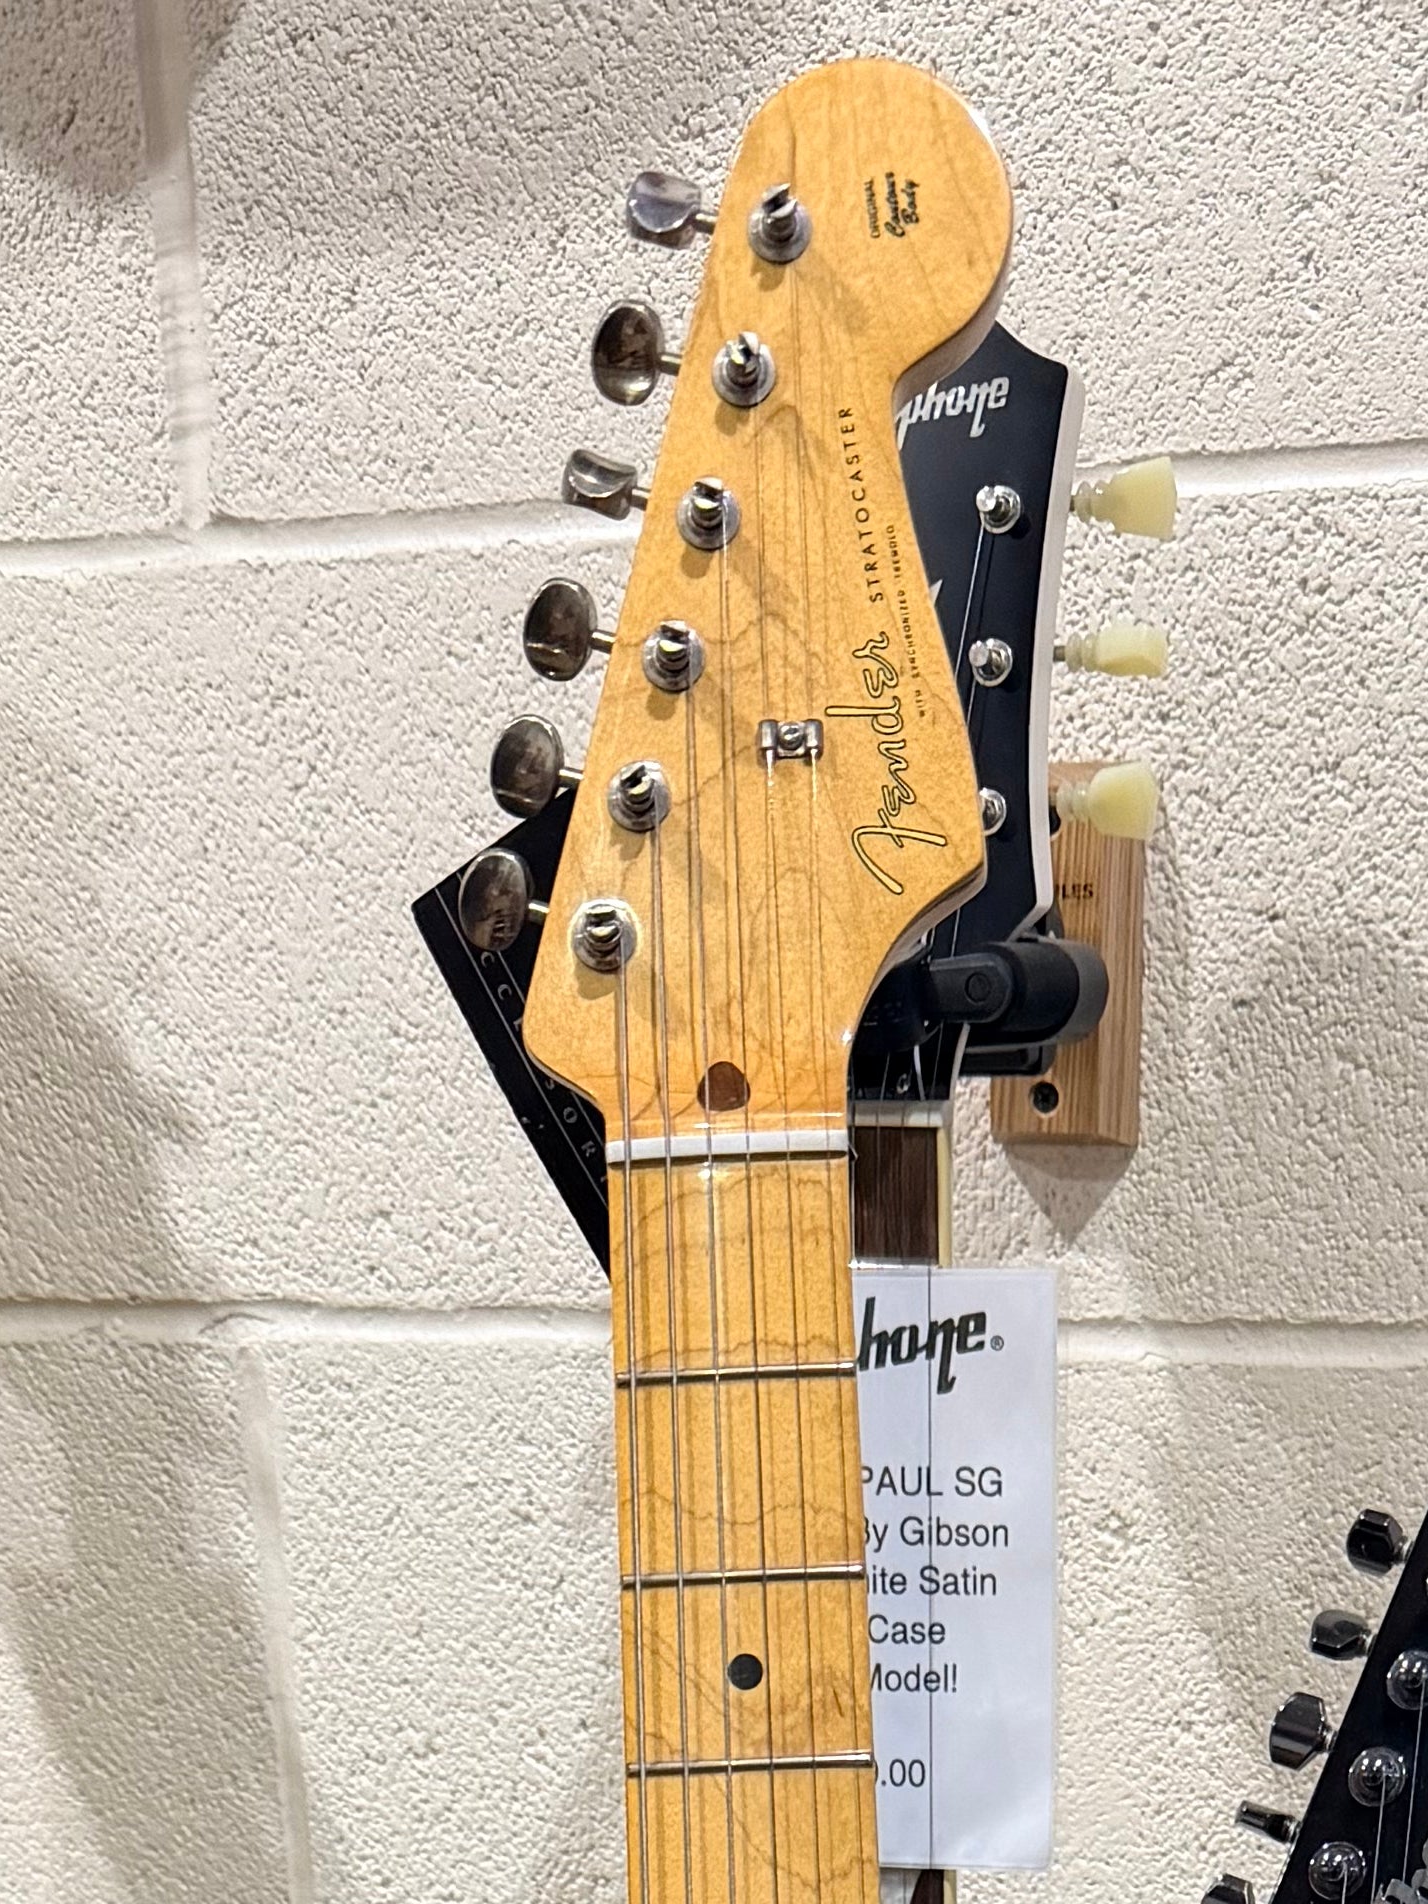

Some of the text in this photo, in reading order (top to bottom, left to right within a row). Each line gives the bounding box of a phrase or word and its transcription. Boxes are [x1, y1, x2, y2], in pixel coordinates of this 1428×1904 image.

[895, 377, 1010, 452] phone
[825, 407, 949, 896] Fender STRATOCASTER
[953, 1466, 1003, 1498] SG
[900, 1516, 1009, 1549] Gibson
[919, 1564, 998, 1596] Satin
[868, 1613, 946, 1645] Case
